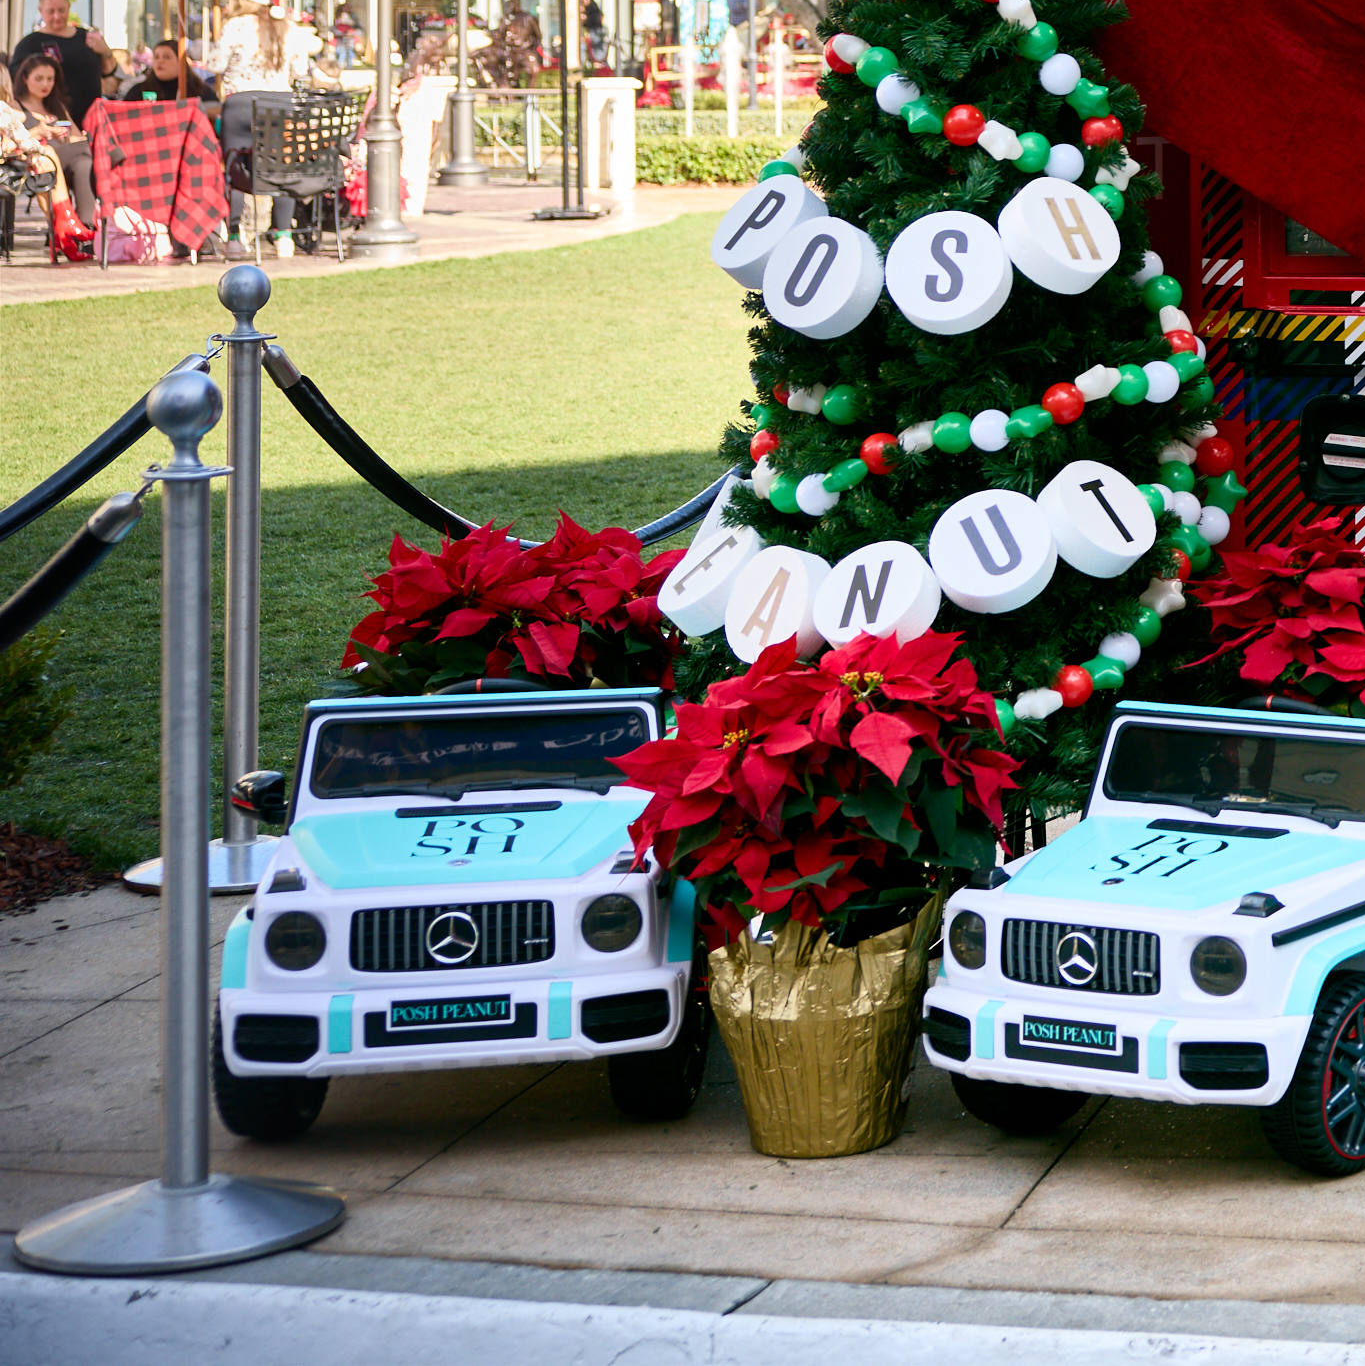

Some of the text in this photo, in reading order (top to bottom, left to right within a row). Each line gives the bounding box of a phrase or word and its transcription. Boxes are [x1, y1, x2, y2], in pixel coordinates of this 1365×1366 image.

[724, 190, 1103, 307] POSH
[673, 479, 1136, 648] EANUT
[421, 816, 525, 837] PO
[410, 834, 519, 857] SH
[1128, 834, 1229, 856] PO
[1089, 852, 1200, 877] SH
[392, 1000, 509, 1023] POSH PEANUT
[1024, 1021, 1116, 1047] POSH PEANUT
